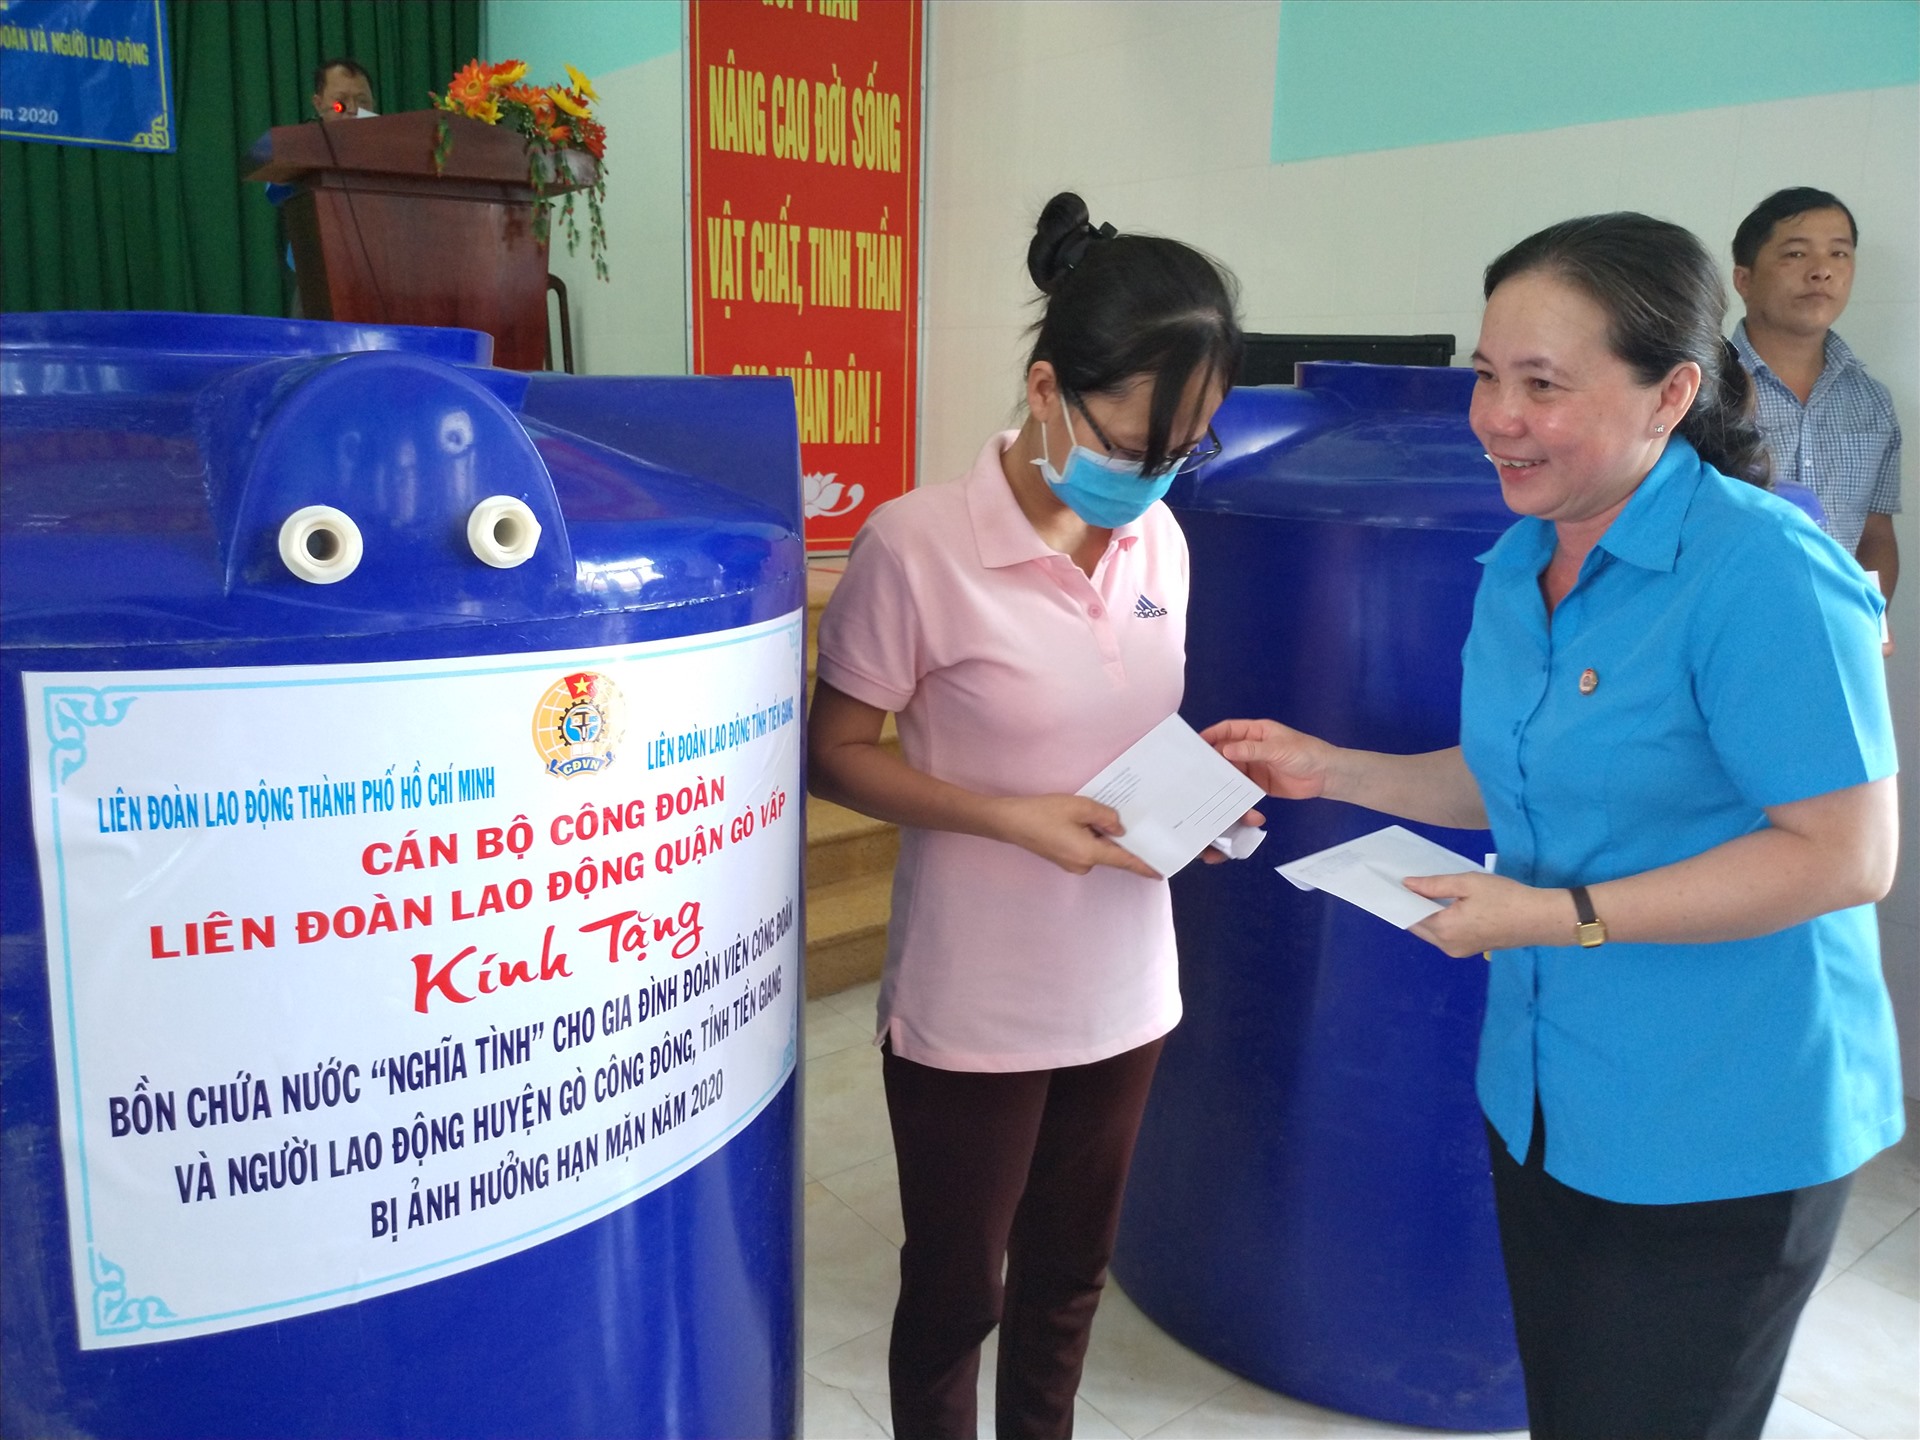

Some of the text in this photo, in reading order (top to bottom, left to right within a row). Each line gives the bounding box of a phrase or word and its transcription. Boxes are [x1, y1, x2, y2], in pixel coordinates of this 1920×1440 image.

[0, 19, 149, 68] OÀN VÀ NGƯỜI LAO ĐỘNG
[18, 106, 59, 125] 2020
[708, 48, 901, 173] NÂNG CAO ĐỜI SỐNG
[707, 194, 902, 319] VẬT CHẤT, TINH THẦN
[834, 353, 870, 444] DÂN
[1134, 607, 1168, 619] adidas
[648, 730, 675, 770] LIÊN
[678, 723, 706, 763] ĐOÀN
[709, 723, 727, 755] LAO
[729, 711, 750, 752] ĐỘNG
[98, 760, 496, 834] LIÊN ĐOÀN LAO ĐỘNG THÀNH PHỐ HỒ CHÍ MINH
[361, 776, 725, 876] CÁN BỘ CÔNG ĐOÀN
[150, 785, 786, 959] LIÊN ĐOÀN LAO ĐỘNG QUẬN GÒ VẤP
[411, 901, 704, 1014] Kính Tặng
[109, 1075, 177, 1138] BỒN
[187, 1070, 272, 1129] CHỨA
[282, 1056, 361, 1115] NƯỚC
[553, 1006, 595, 1052] CHO
[602, 993, 632, 1037] GIA
[638, 975, 678, 1024] ĐÌNH
[683, 950, 721, 1003] ĐOÀN
[724, 932, 750, 980] VIÊN
[751, 917, 775, 962] CÔNG
[776, 895, 793, 942] ĐOÀN
[174, 964, 782, 1204] VÀ NGƯỜI LAO ĐỘNG HUYỆN GÒ CÔNG ĐÔNG, TỈNH TIỀN GIANG
[371, 1067, 724, 1243] BỊ ẢNH HƯỞNG HẠN MẶN NĂM 2020
